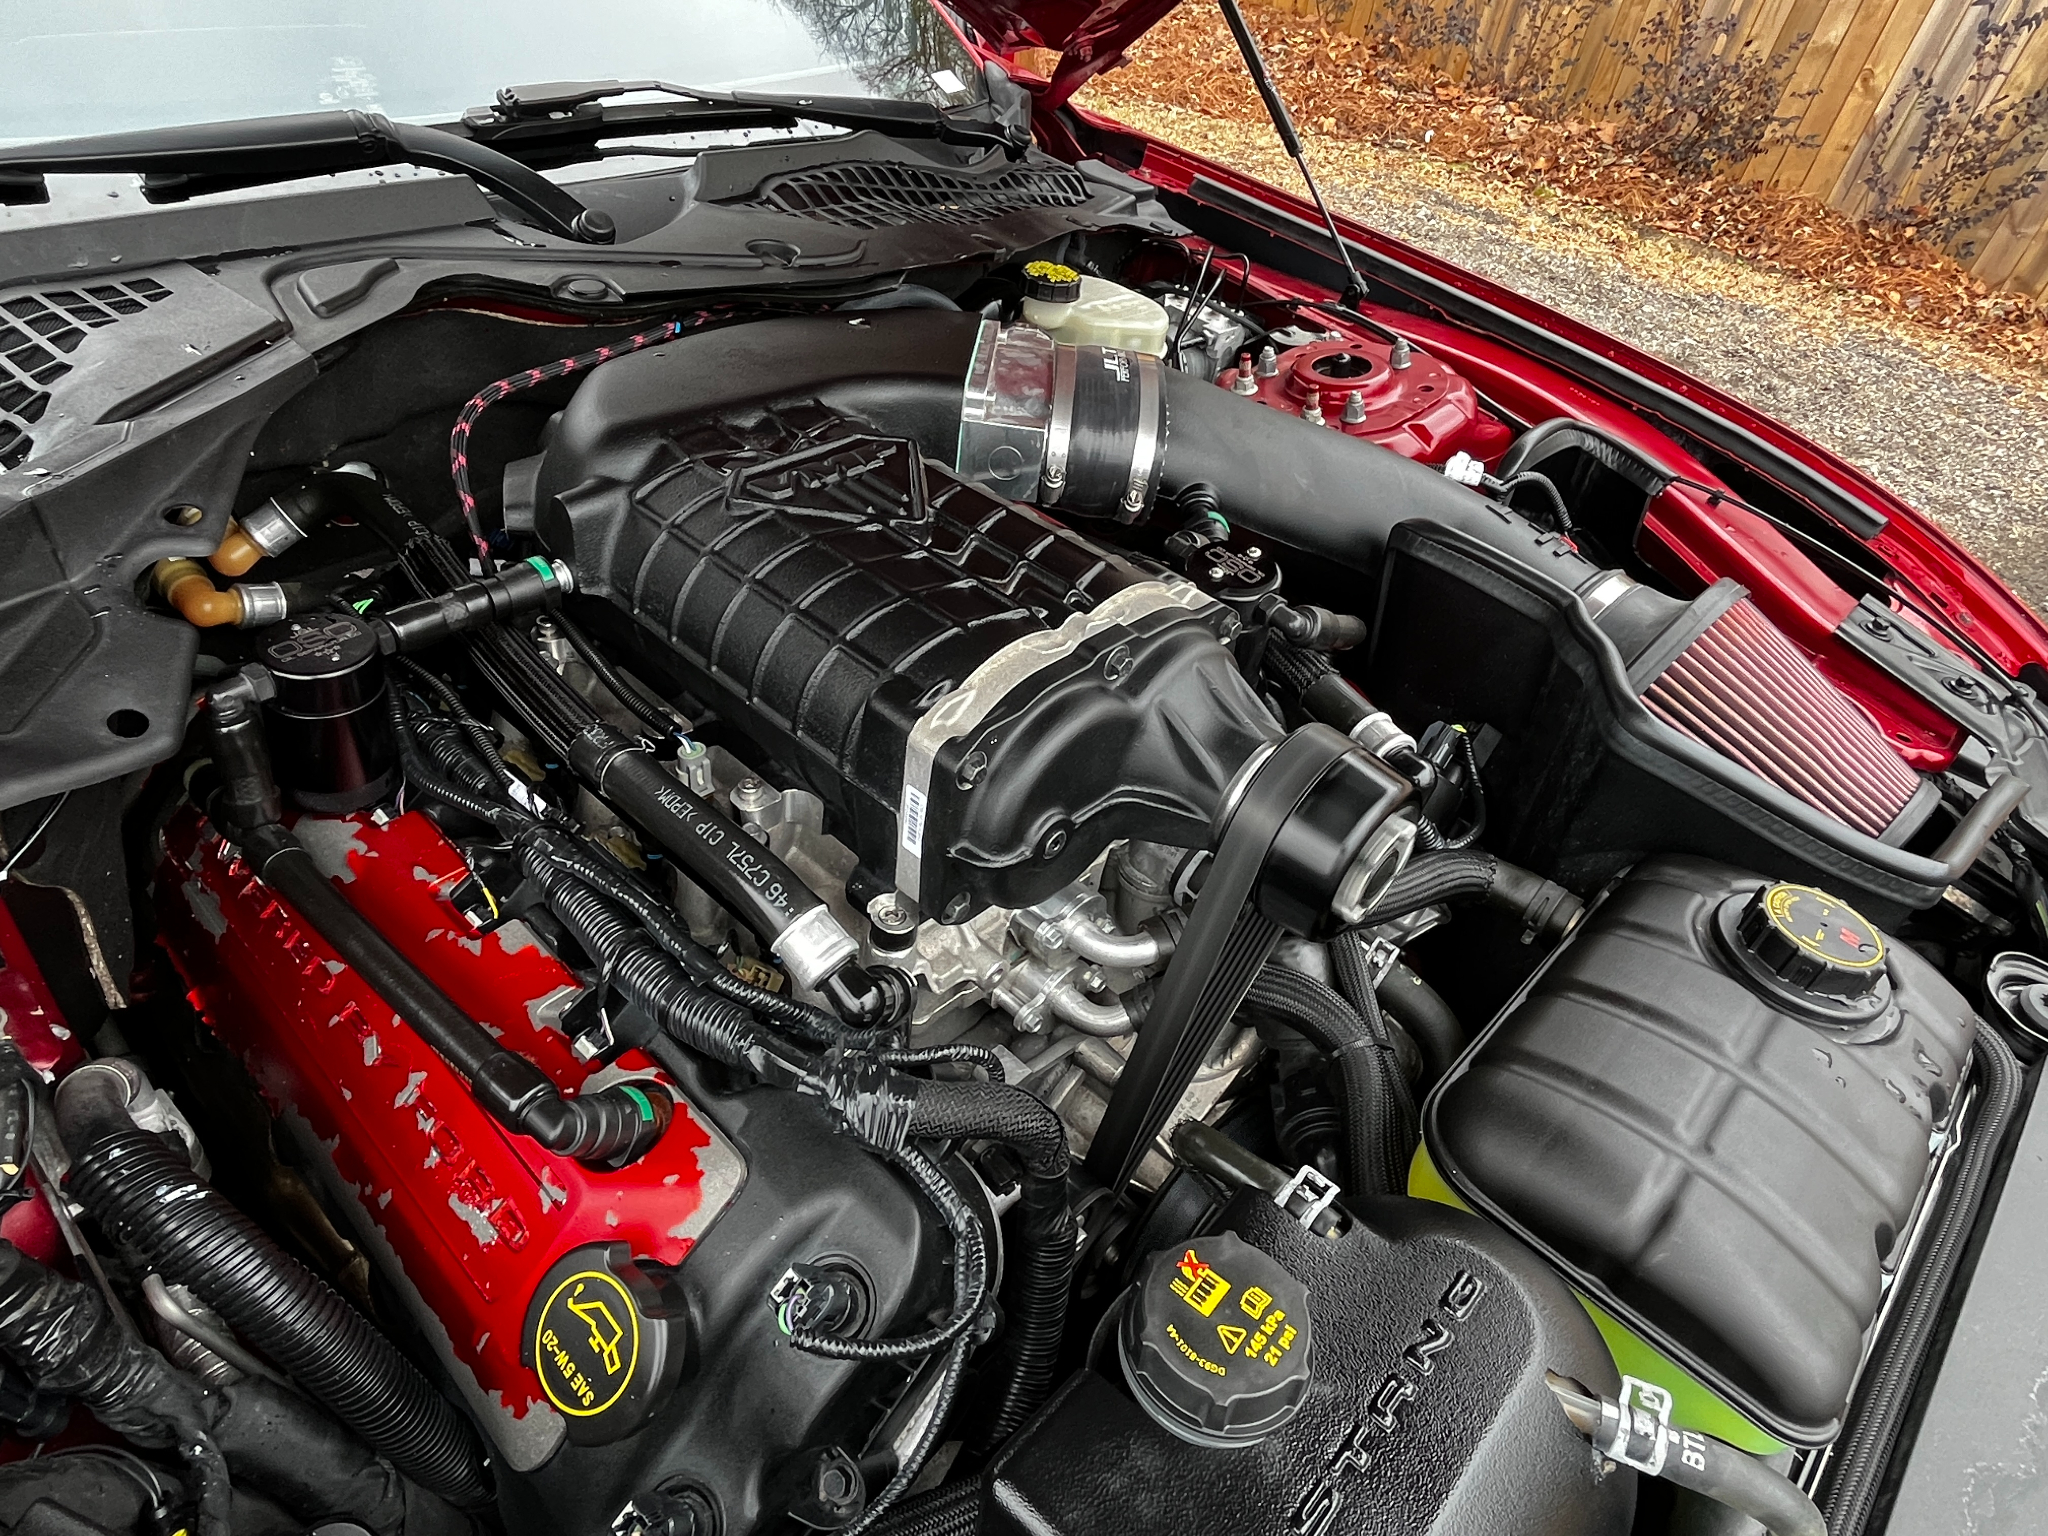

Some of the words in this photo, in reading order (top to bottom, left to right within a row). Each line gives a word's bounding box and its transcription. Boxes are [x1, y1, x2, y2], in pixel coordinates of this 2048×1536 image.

[1101, 346, 1121, 382] JLT
[726, 841, 772, 887] C757L
[403, 1080, 531, 1253] FORD
[541, 1329, 576, 1380] 5W-20
[1244, 1331, 1269, 1360] 145
[1260, 1308, 1287, 1337] kPa
[1262, 1344, 1283, 1368] 21
[1277, 1323, 1299, 1351] psi
[569, 1371, 595, 1407] SAE
